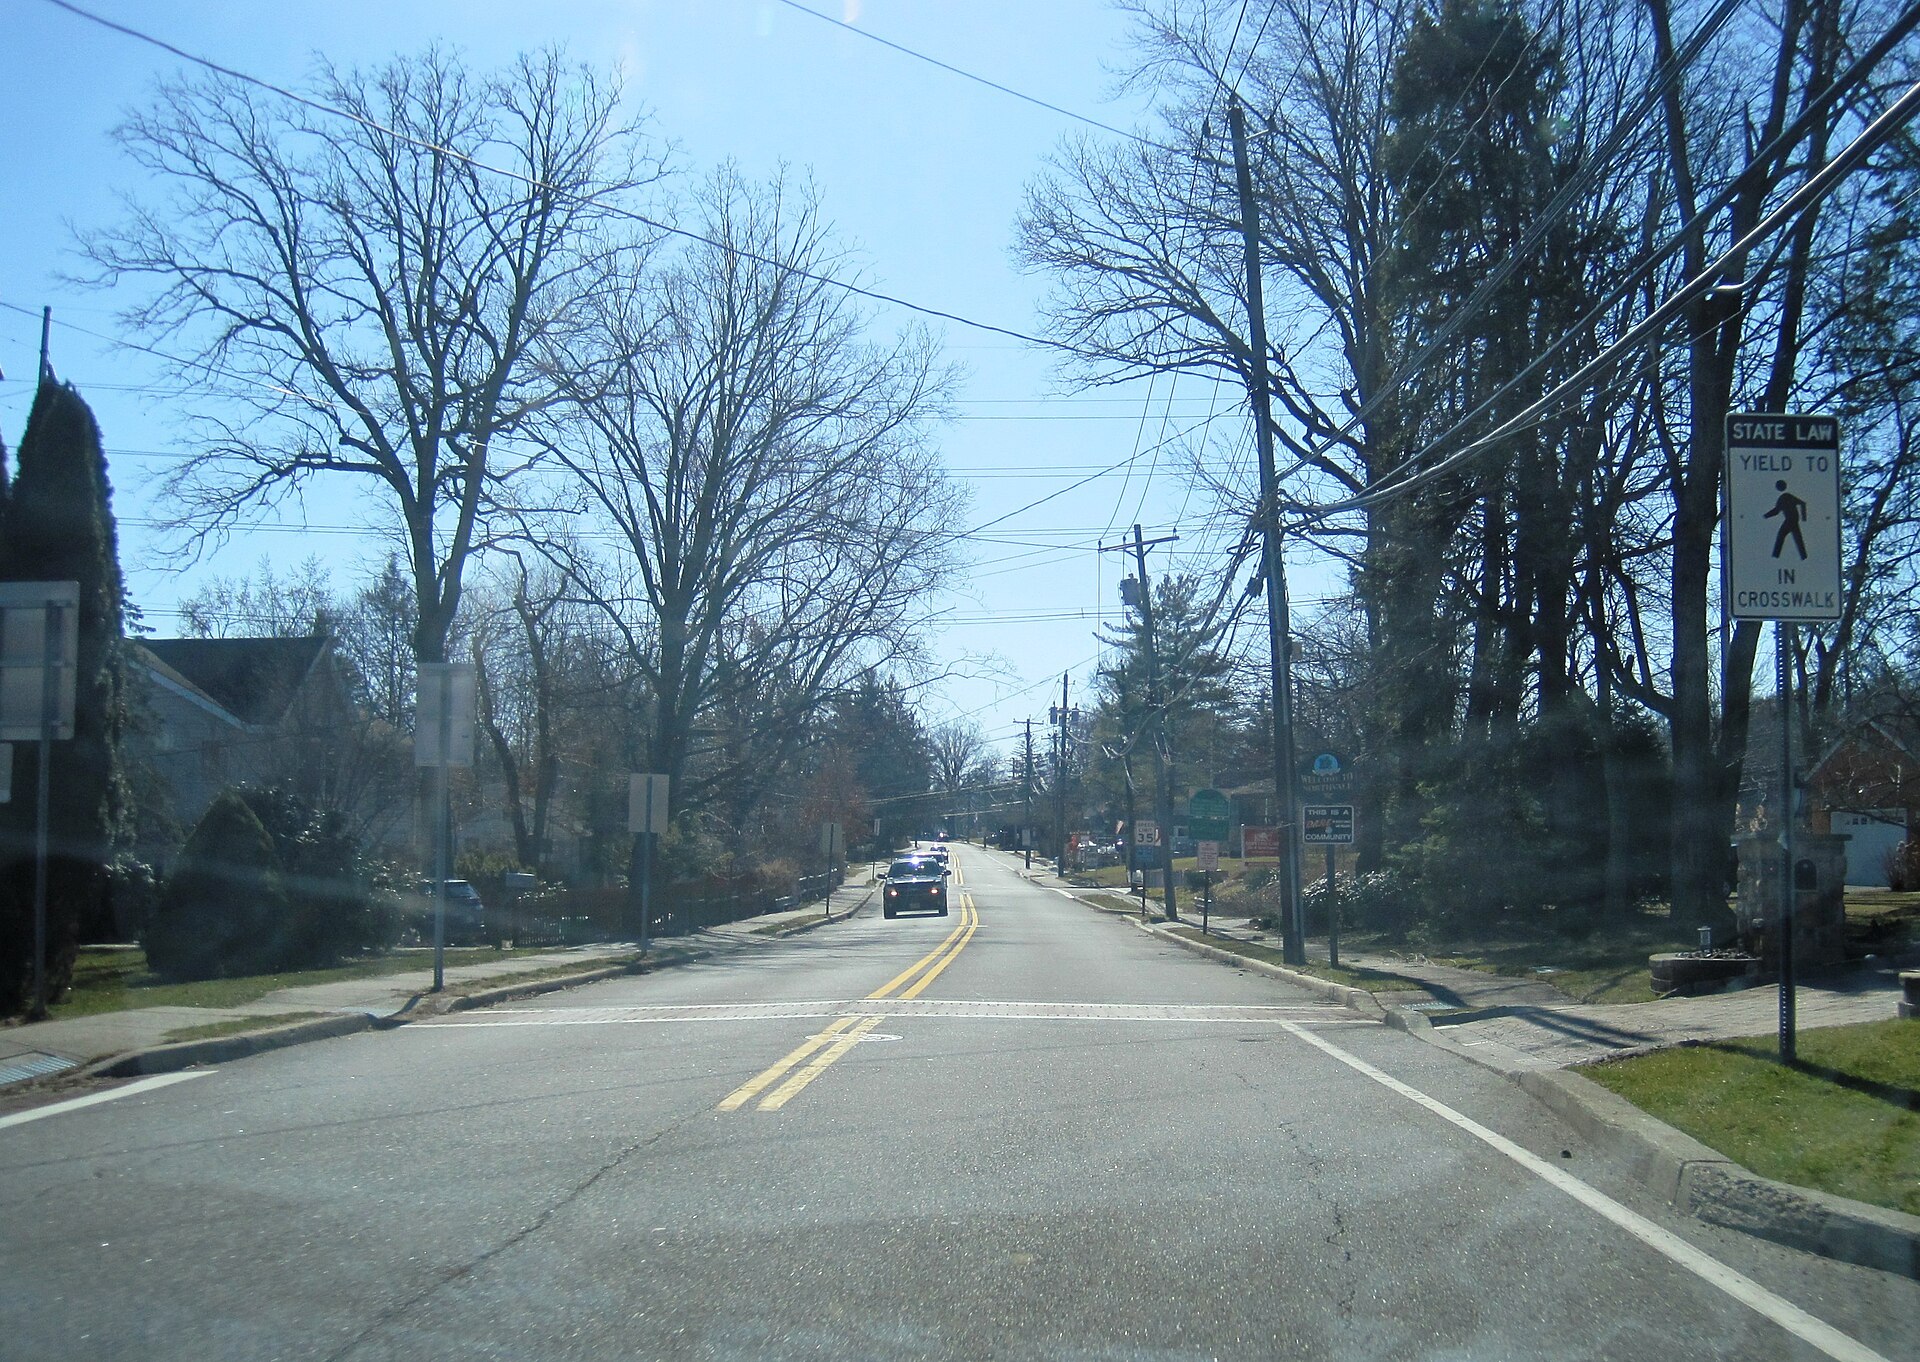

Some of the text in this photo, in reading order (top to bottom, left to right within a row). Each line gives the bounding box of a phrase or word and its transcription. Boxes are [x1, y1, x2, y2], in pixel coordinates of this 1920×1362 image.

[1733, 423, 1832, 441] STATE LAW
[1739, 455, 1829, 472] YIELD TO
[1778, 568, 1796, 585] IN
[1738, 591, 1835, 609] CROSSWALK
[1137, 833, 1154, 843] 35
